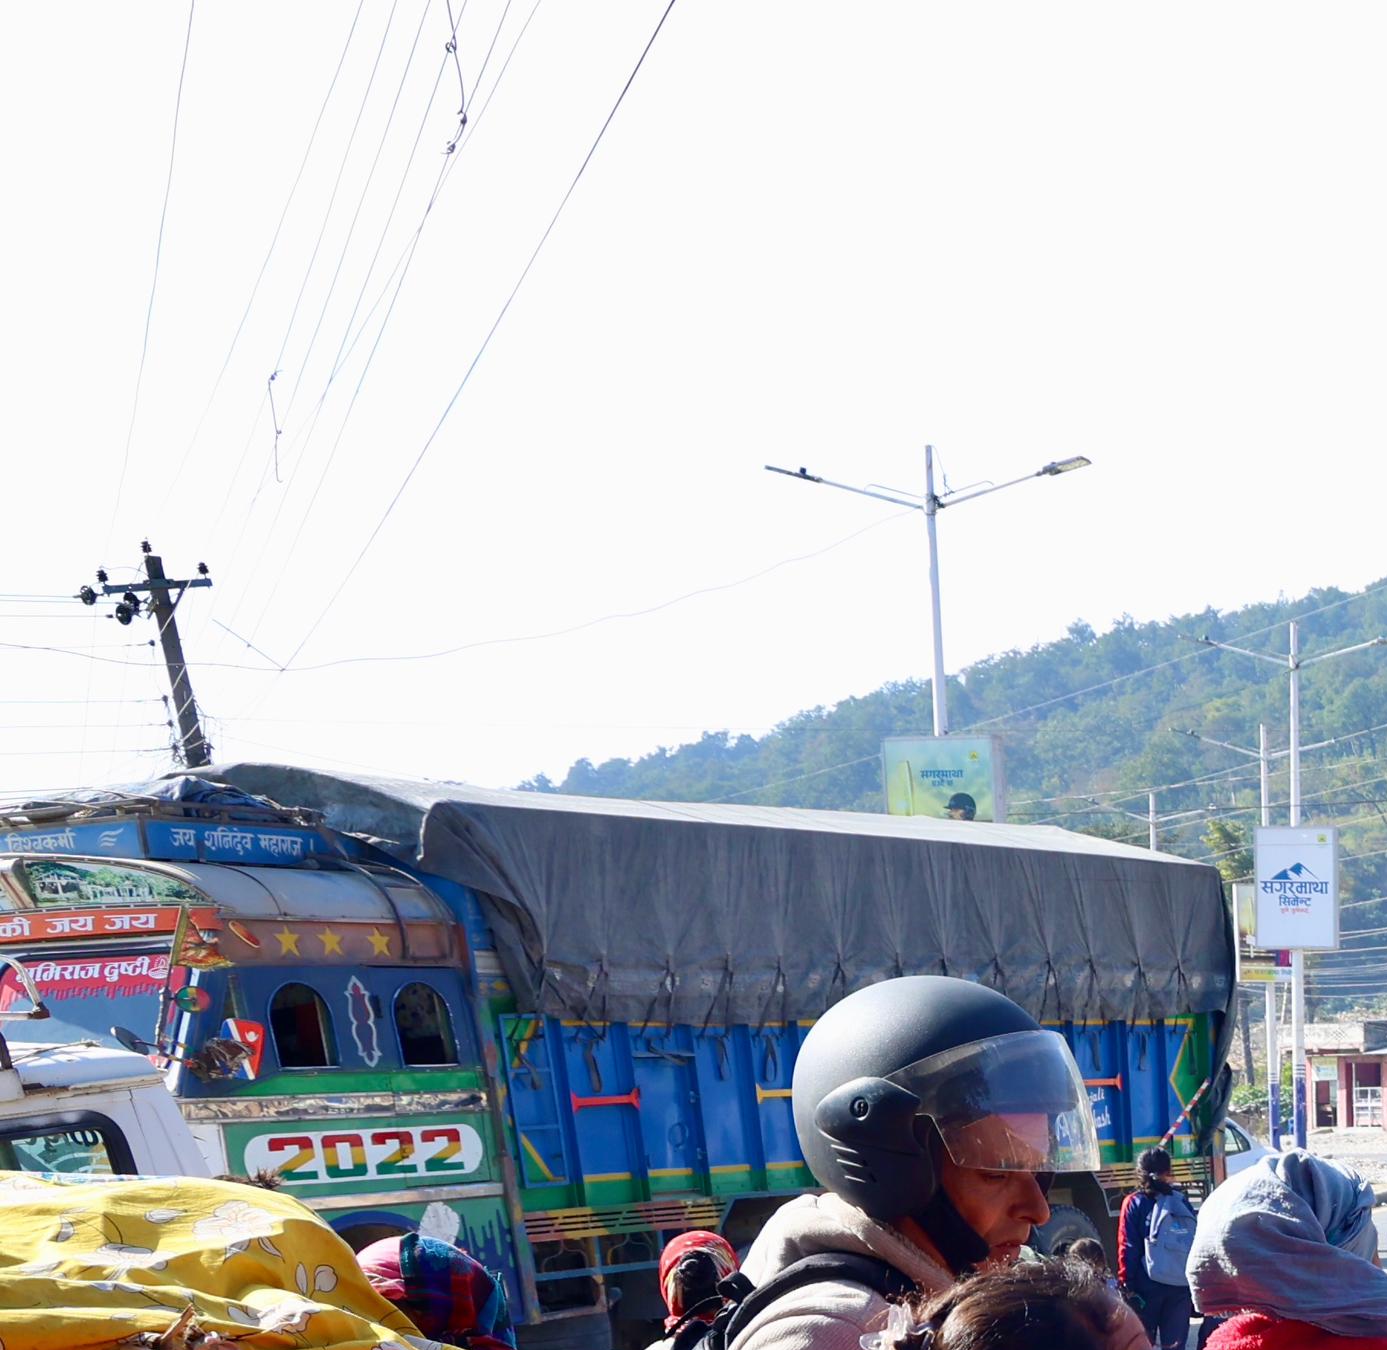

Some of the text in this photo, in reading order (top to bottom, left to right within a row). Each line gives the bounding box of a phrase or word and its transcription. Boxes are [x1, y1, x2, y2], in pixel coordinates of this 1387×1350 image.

[170, 827, 196, 847] जय
[258, 833, 303, 856] महाराज
[1260, 880, 1329, 896] सगरमाथा
[46, 915, 95, 935] जय
[105, 913, 158, 932] जय
[266, 1127, 465, 1182] 2022
